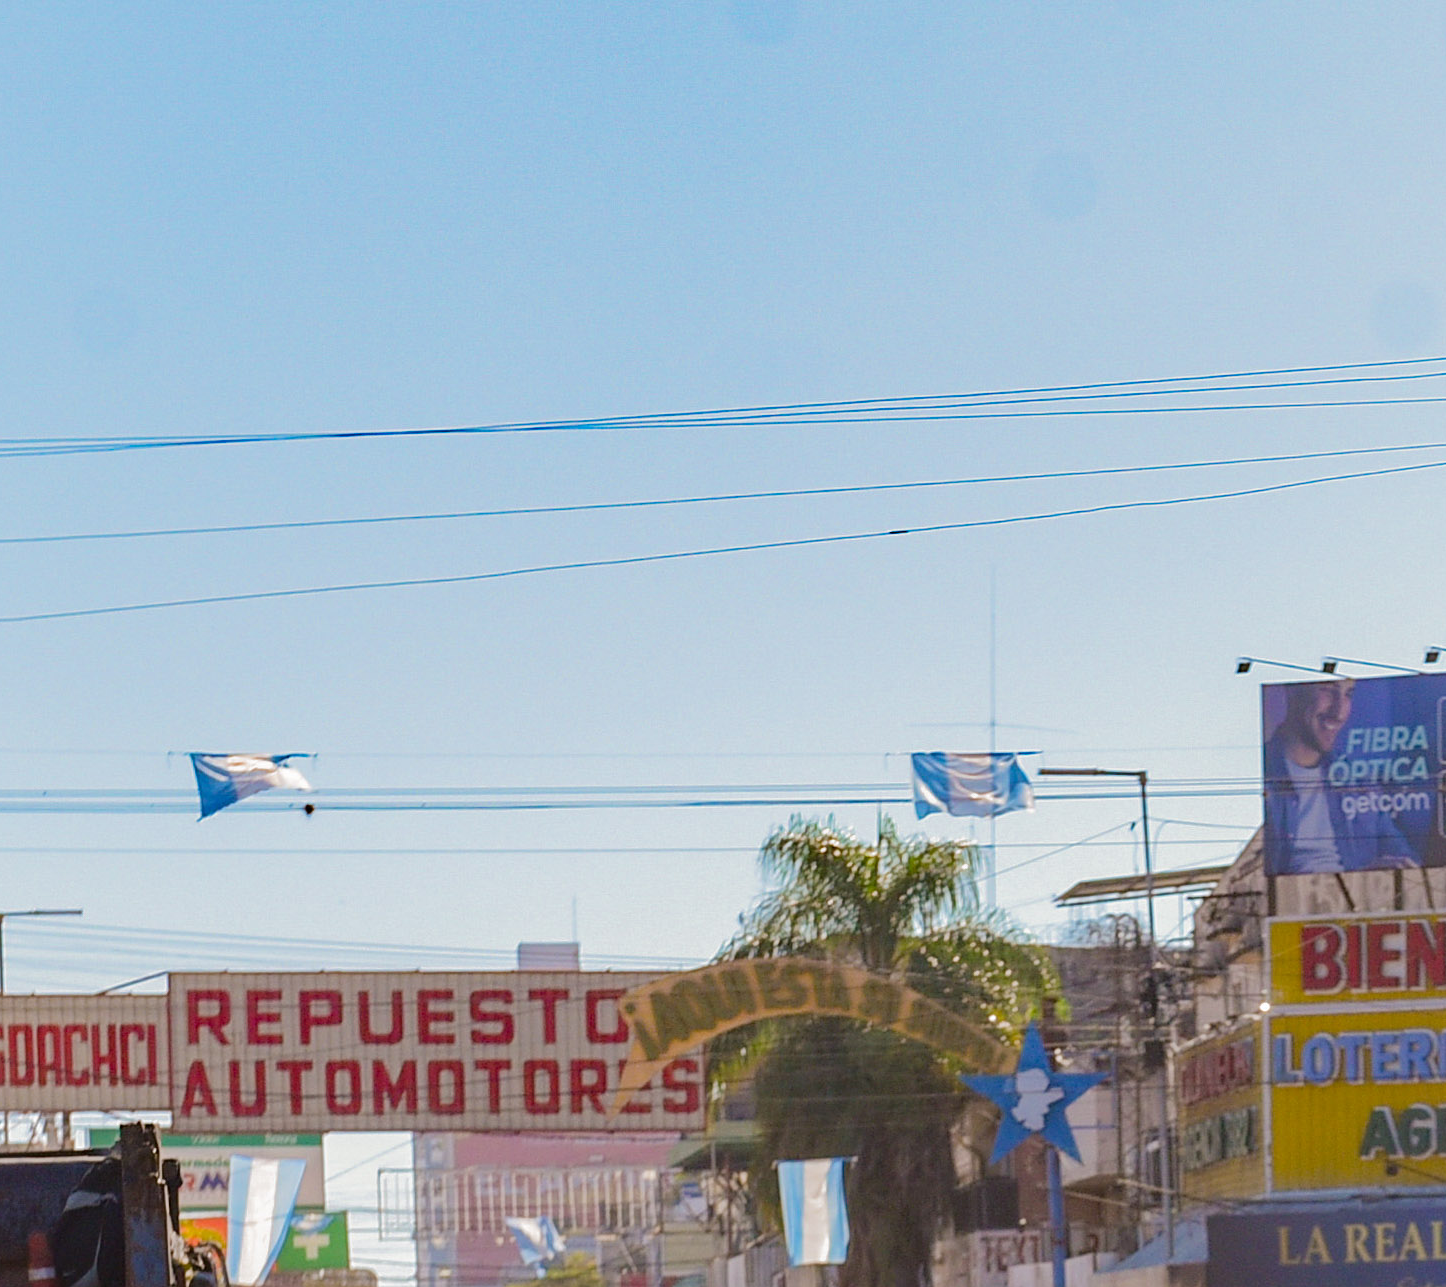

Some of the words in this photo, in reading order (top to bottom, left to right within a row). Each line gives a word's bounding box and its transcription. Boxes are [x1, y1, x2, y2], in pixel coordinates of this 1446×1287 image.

[1346, 725, 1429, 753] FIBRA
[1328, 754, 1430, 786] ÓPTICA
[1341, 791, 1431, 819] getcom
[186, 988, 630, 1045] REPUESTO
[1277, 1224, 1334, 1267] LA
